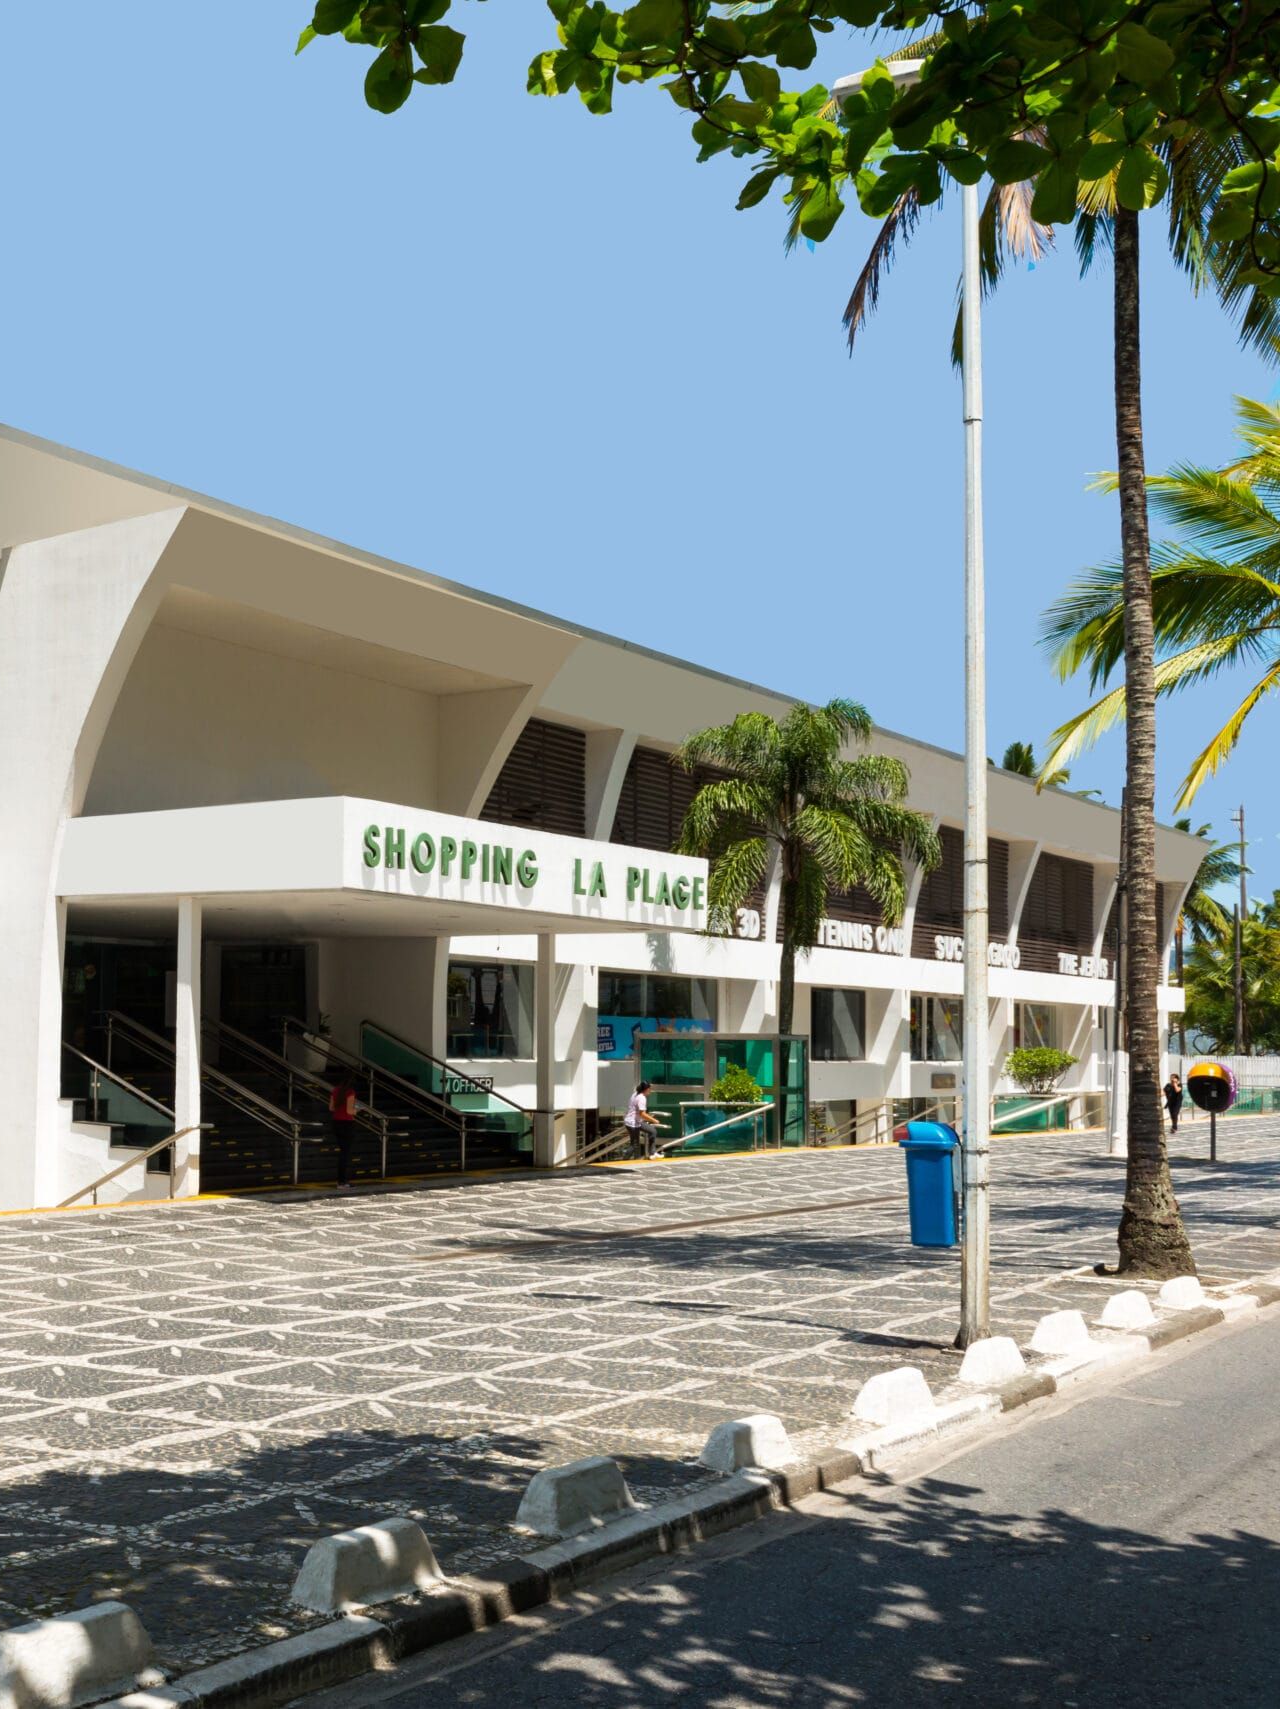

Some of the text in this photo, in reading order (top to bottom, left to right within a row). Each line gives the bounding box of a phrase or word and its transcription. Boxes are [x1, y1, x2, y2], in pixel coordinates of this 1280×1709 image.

[363, 824, 705, 911] SHOPPING LA PLAGE
[736, 907, 760, 938] 3D
[817, 918, 873, 951] TENNIS
[934, 935, 965, 960] SUC
[1058, 952, 1078, 975] THE
